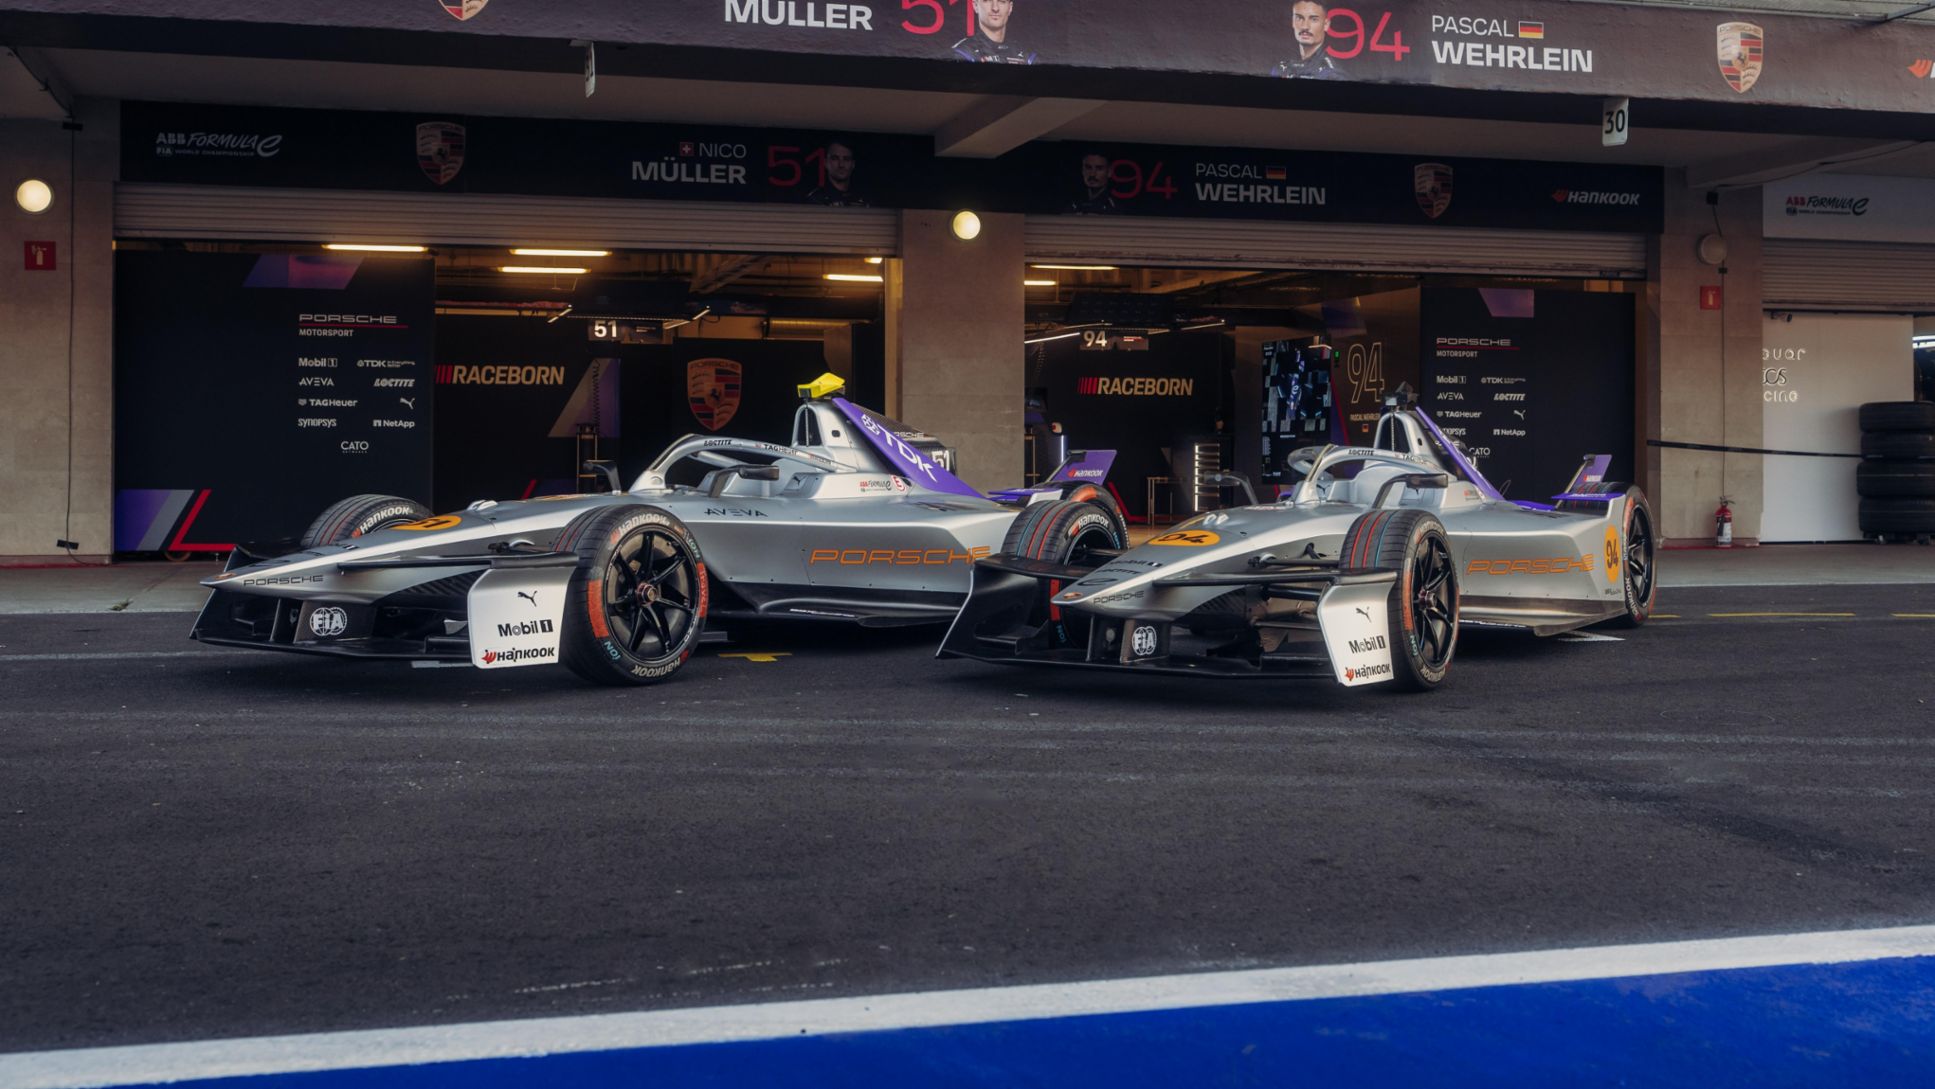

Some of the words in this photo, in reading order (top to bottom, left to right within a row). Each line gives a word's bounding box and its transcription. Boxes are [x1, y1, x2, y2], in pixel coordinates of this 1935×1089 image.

[1326, 8, 1410, 61] 94
[1432, 15, 1514, 38] PASCAL
[1431, 40, 1593, 73] WEHRLEIN
[1604, 109, 1625, 134] 30
[156, 132, 186, 145] ABB
[187, 132, 260, 149] FORMULA
[699, 142, 748, 159] NICO
[631, 156, 747, 184] MÜLLER
[767, 145, 827, 188] 51
[1195, 162, 1263, 179] PASCAL
[1110, 159, 1179, 200] 94
[1195, 182, 1327, 206] WEHRLEIN
[1786, 196, 1806, 206] ABB
[1807, 196, 1854, 209] FORMULA
[299, 314, 398, 324] PORSCHE
[299, 328, 354, 337] MOTORSPORT
[594, 320, 617, 338] 51
[1083, 330, 1107, 347] 94
[1436, 337, 1512, 346] PORSCHE
[298, 358, 327, 367] Mobil
[364, 359, 387, 368] TDK
[452, 365, 565, 385] RACEBORN
[1347, 341, 1385, 404] 94
[1436, 375, 1458, 384] Mobil
[299, 377, 336, 387] AVEVA
[373, 378, 416, 388] LOCTITE
[1097, 377, 1194, 397] RACEBORN
[1437, 391, 1464, 400] AVEVA
[1493, 393, 1526, 401] LOCTITE
[383, 420, 416, 429] NetApp
[1501, 429, 1526, 437] NetApp
[341, 440, 370, 451] CATO
[703, 439, 732, 447] LOCTITE
[877, 424, 938, 483] TDK
[931, 449, 951, 472] 51
[1157, 533, 1208, 544] 94
[808, 546, 991, 567] PORSCHE
[1606, 539, 1619, 569] 94
[1466, 554, 1595, 576] PORSCHE
[243, 575, 324, 587] PORSCHE
[1093, 590, 1145, 605] PORSCHE
[497, 620, 538, 637] Mobil
[540, 619, 554, 634] 1
[1348, 636, 1377, 654] Mobil
[1377, 635, 1386, 649] 1
